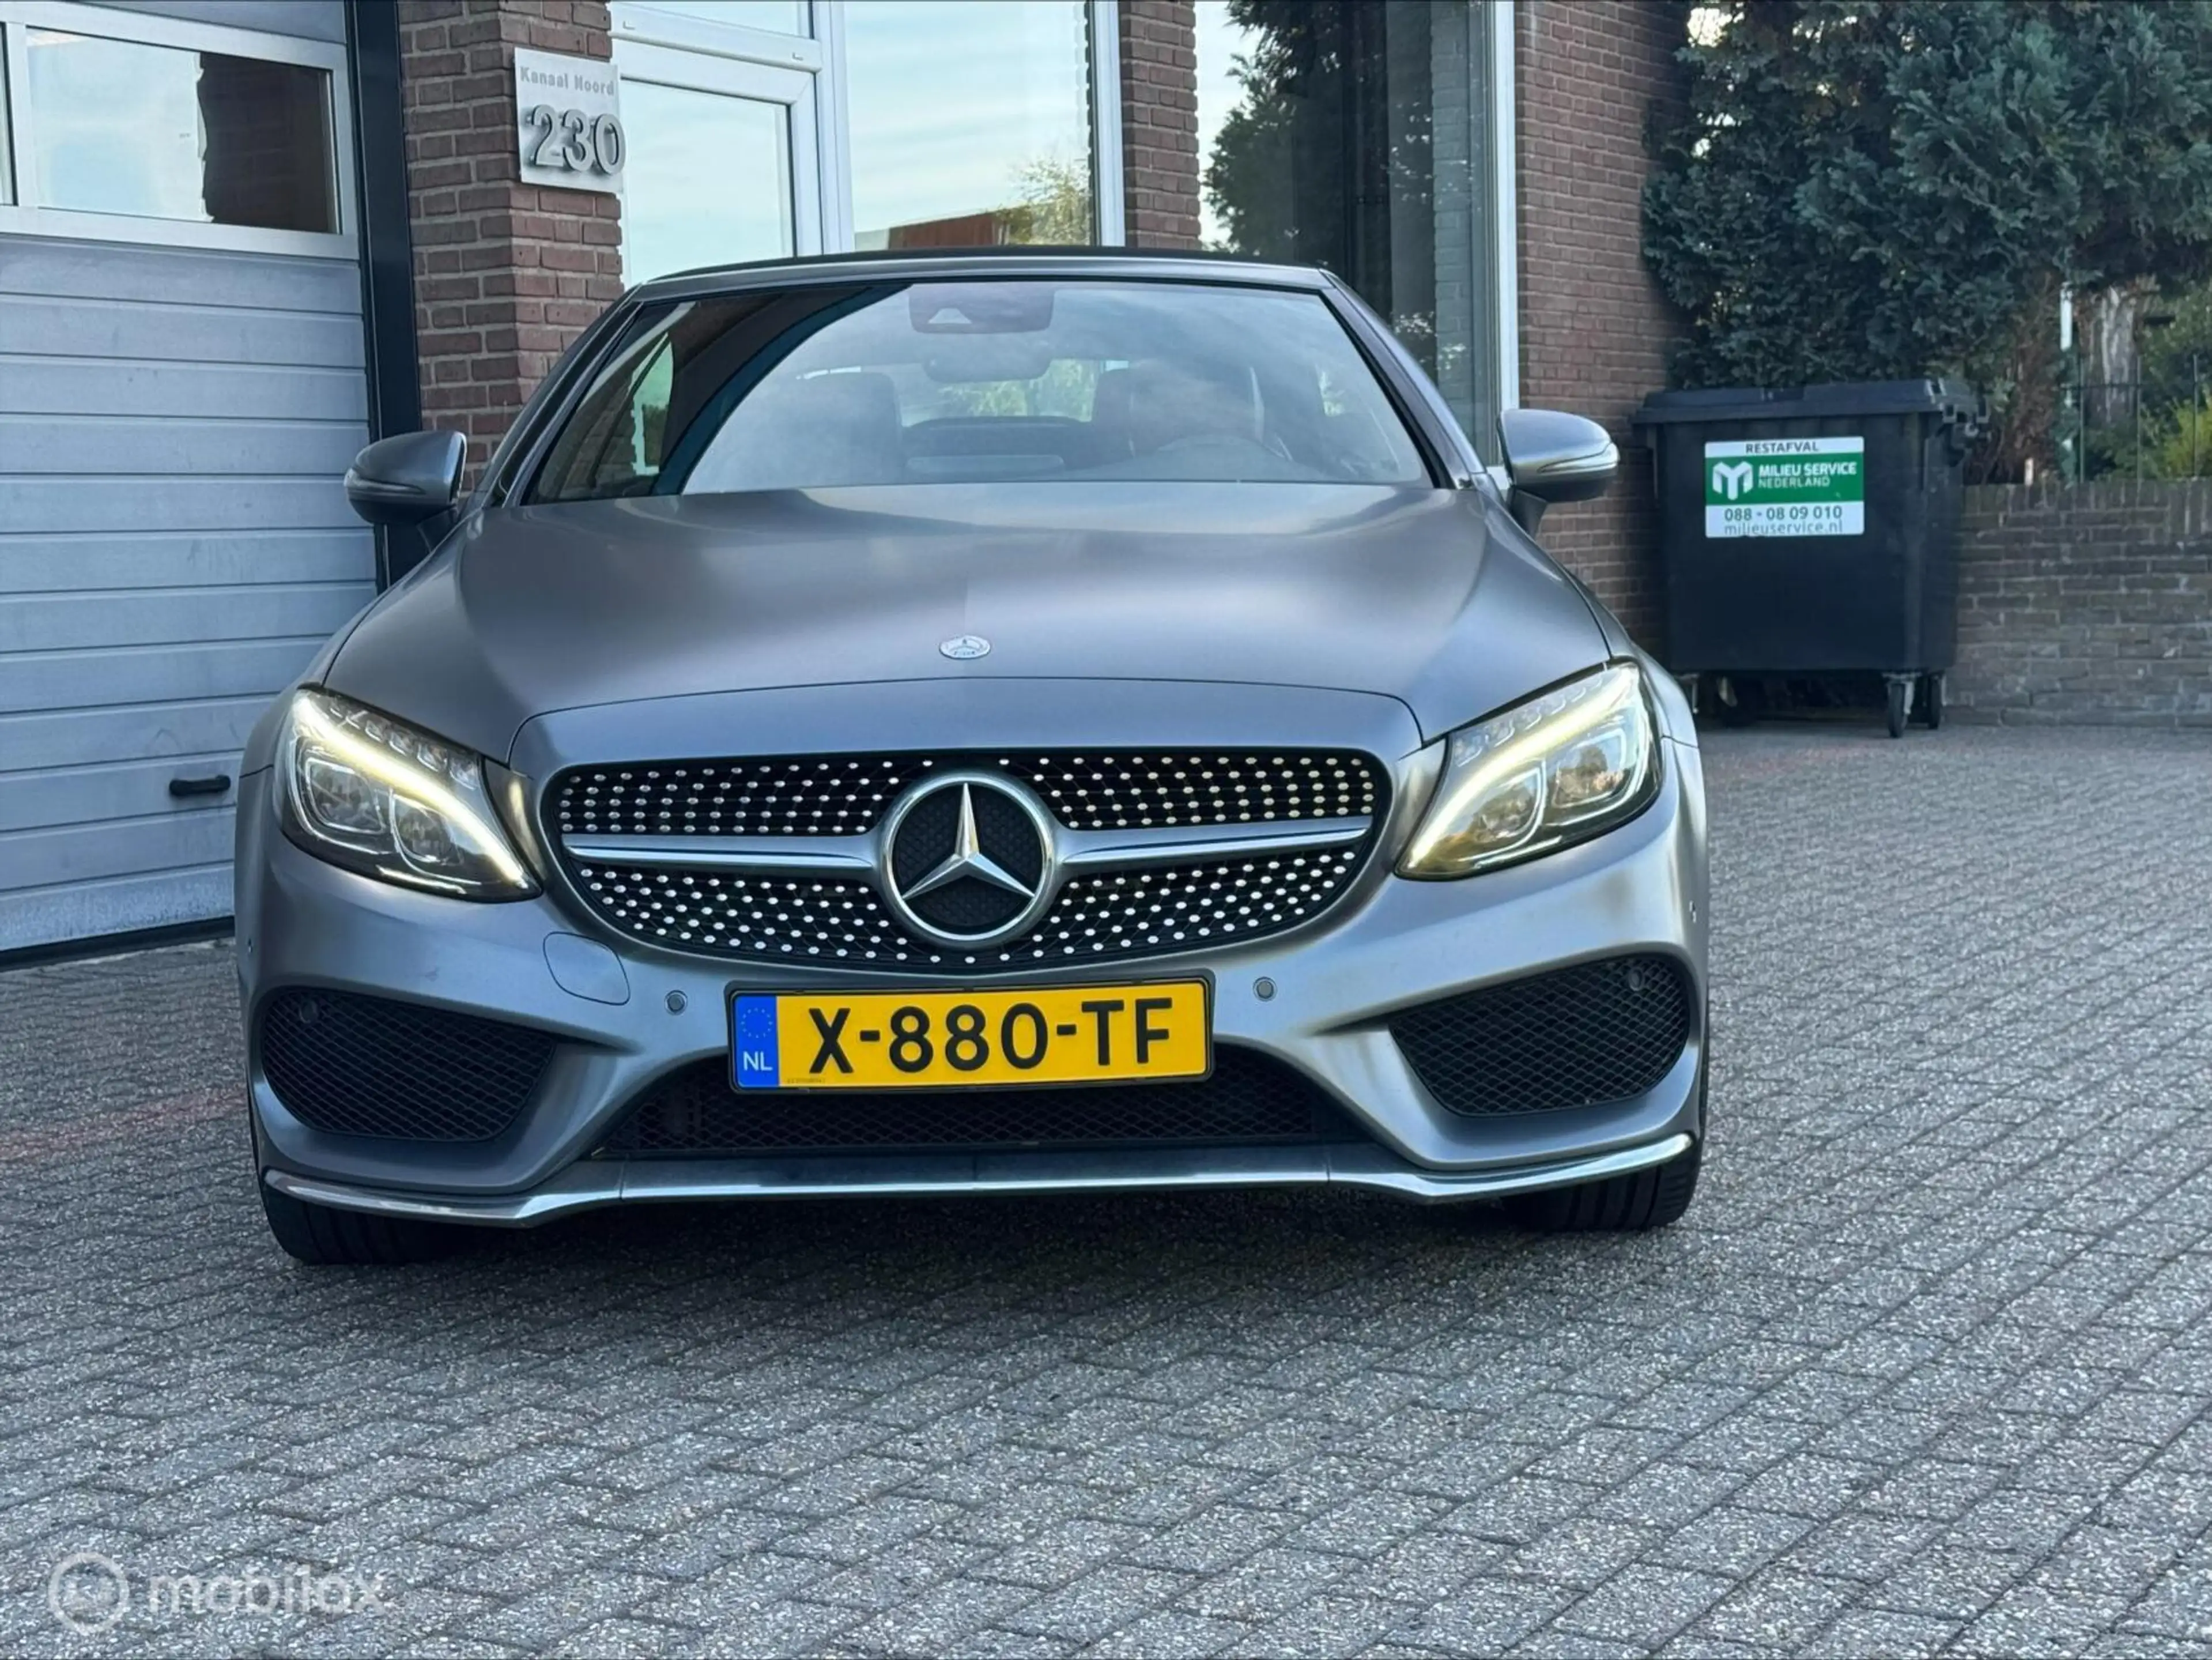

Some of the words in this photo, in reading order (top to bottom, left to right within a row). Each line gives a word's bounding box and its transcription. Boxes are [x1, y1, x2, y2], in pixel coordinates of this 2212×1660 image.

[574, 74, 614, 96] Noord
[531, 104, 626, 175] 230
[1746, 442, 1819, 454] RESTAFVAL
[1758, 464, 1801, 477] MILIEU
[1803, 462, 1857, 476] SERVICE
[1758, 476, 1830, 489] NEDERLAND
[1724, 508, 1753, 521] 088
[1766, 507, 1784, 520] 08
[1789, 507, 1809, 519] 09
[1813, 505, 1843, 518] 010
[1724, 519, 1843, 535] milieuservice.nl
[808, 997, 1173, 1074] X-880-TF
[743, 1051, 772, 1071] NL
